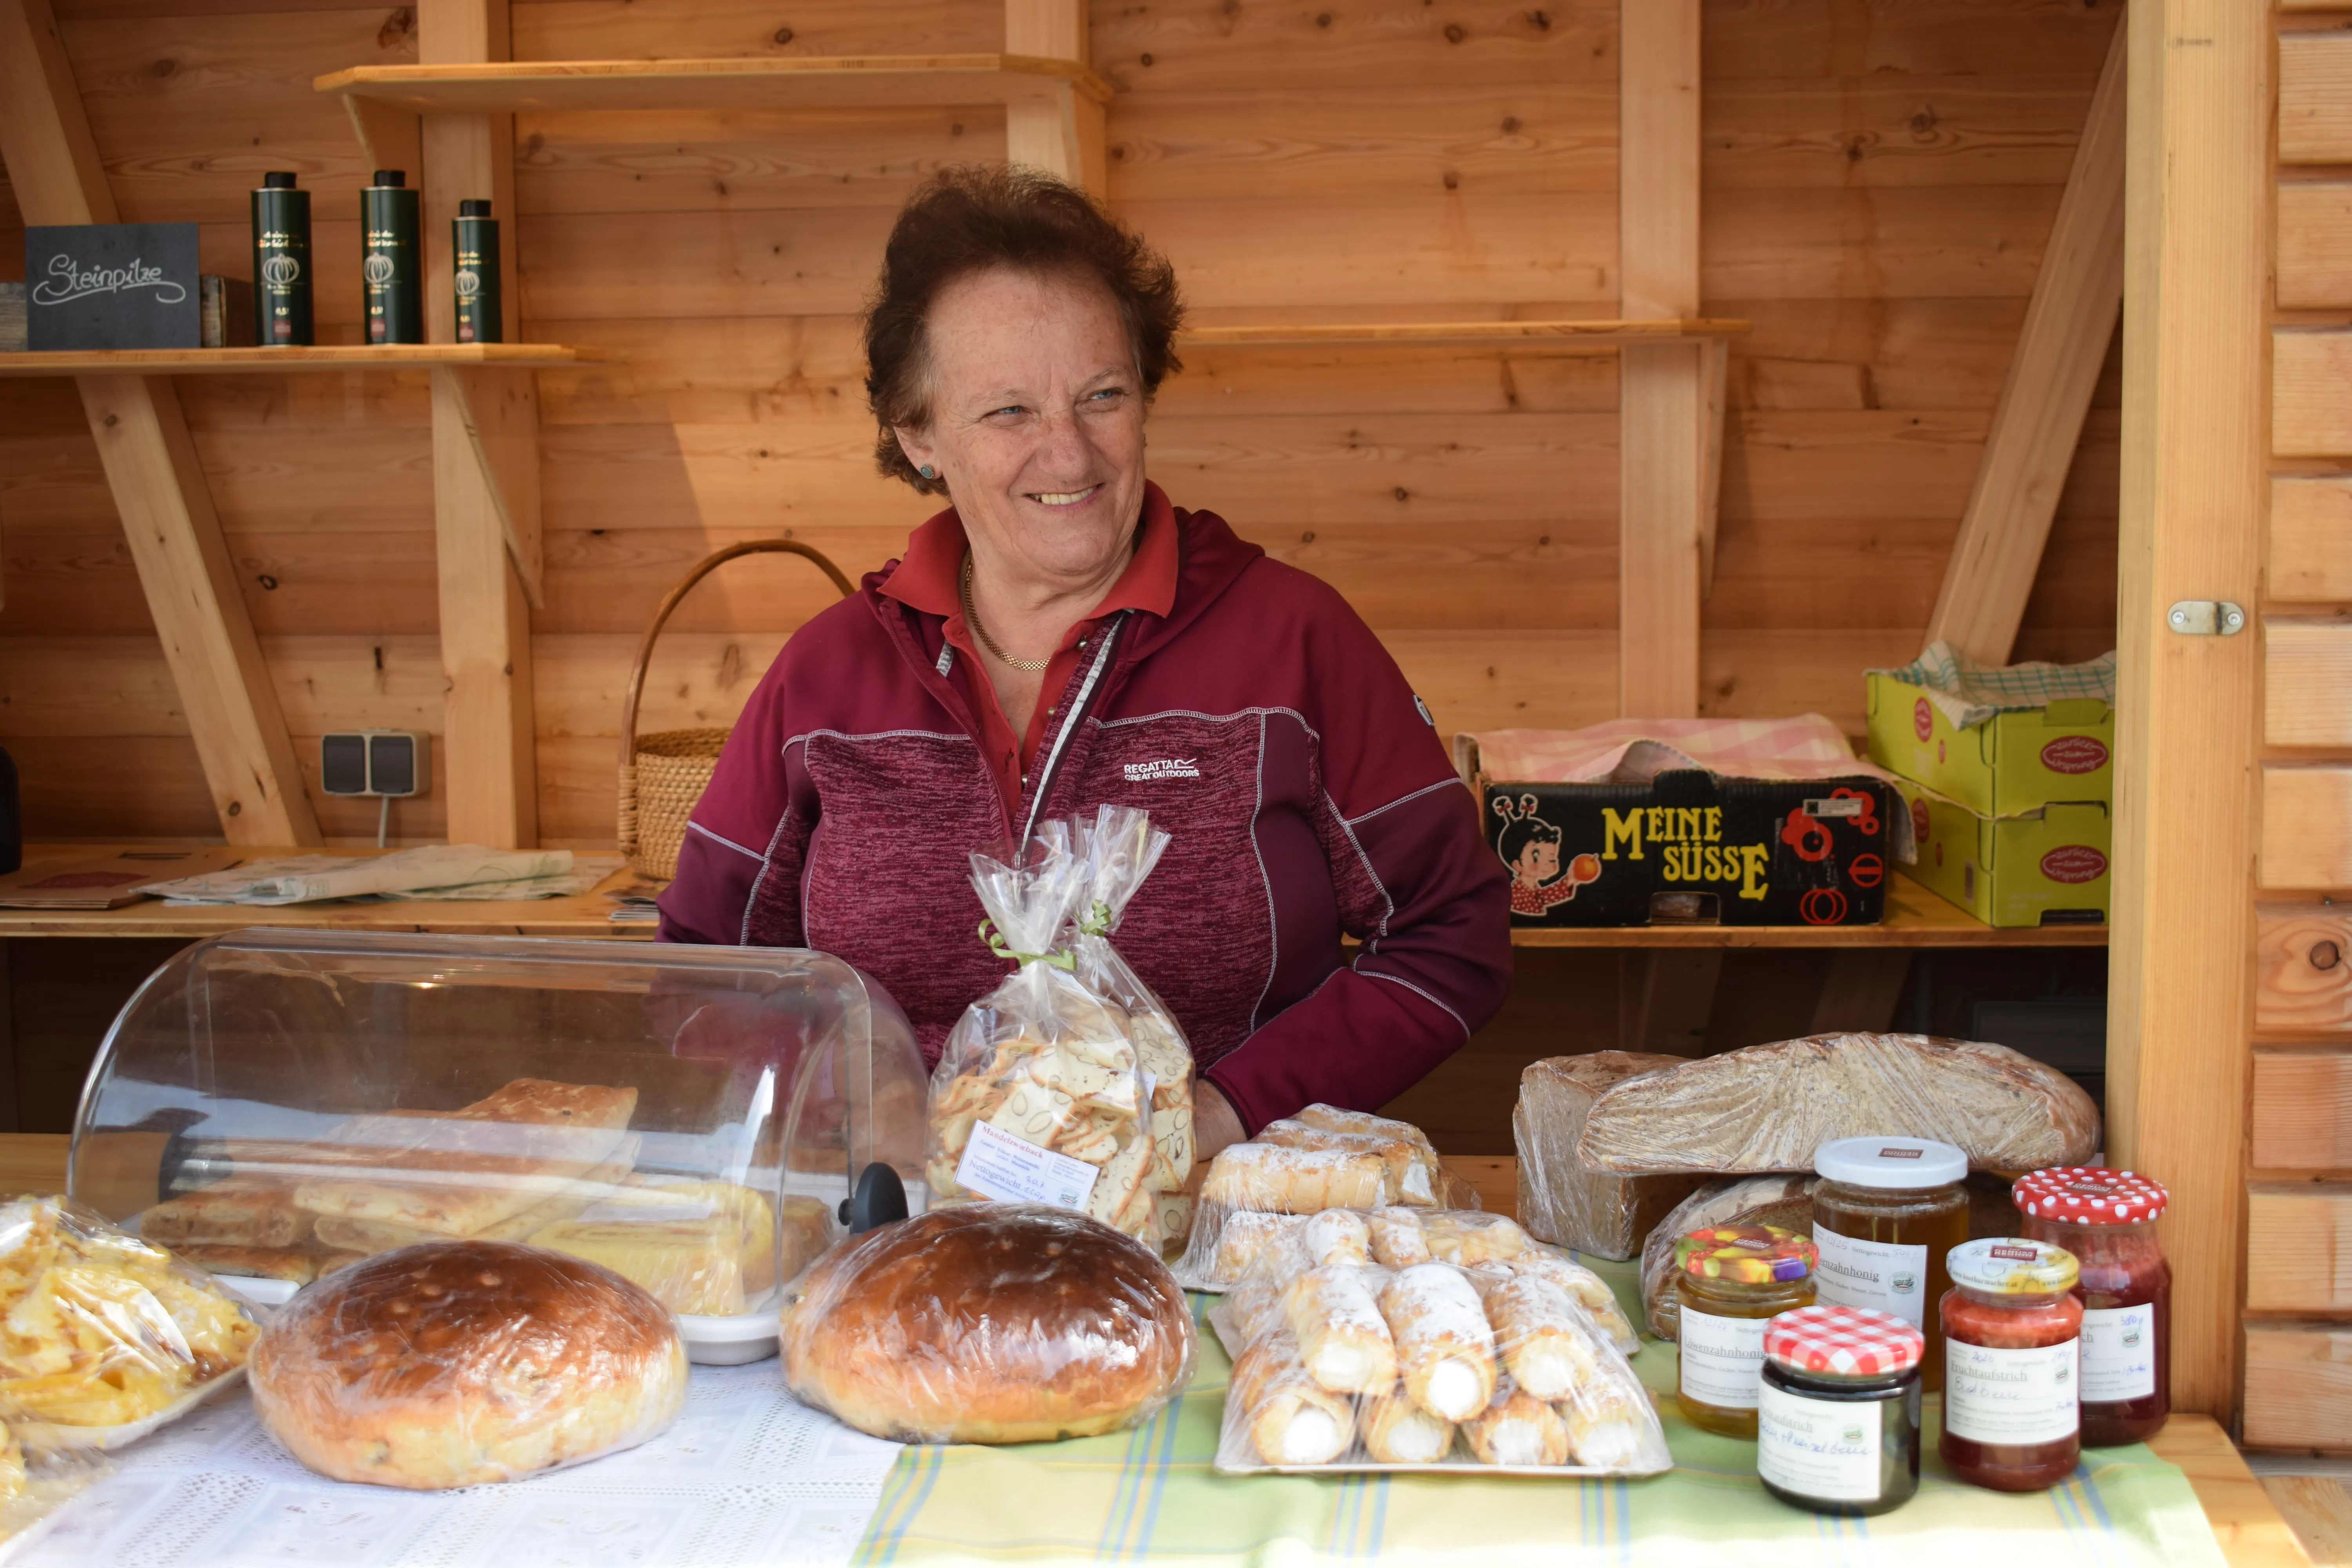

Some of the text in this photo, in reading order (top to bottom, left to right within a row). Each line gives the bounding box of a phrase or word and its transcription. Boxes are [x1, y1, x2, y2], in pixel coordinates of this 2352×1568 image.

[47, 254, 163, 296] Steinpilze
[1124, 759, 1174, 774] REGATTA
[1125, 769, 1200, 781] GREAT OUTDOORS
[1601, 805, 1722, 860] MEINE
[1663, 841, 1769, 901] SÜSSE
[982, 1125, 1043, 1159] Mandelzwieback
[1851, 1246, 1890, 1257] Nettogewicht:
[1700, 1316, 1731, 1332] 12/25
[1685, 1335, 1767, 1360] Löwenzahnhonig
[1951, 1359, 2027, 1381] Fruchtaufstrich
